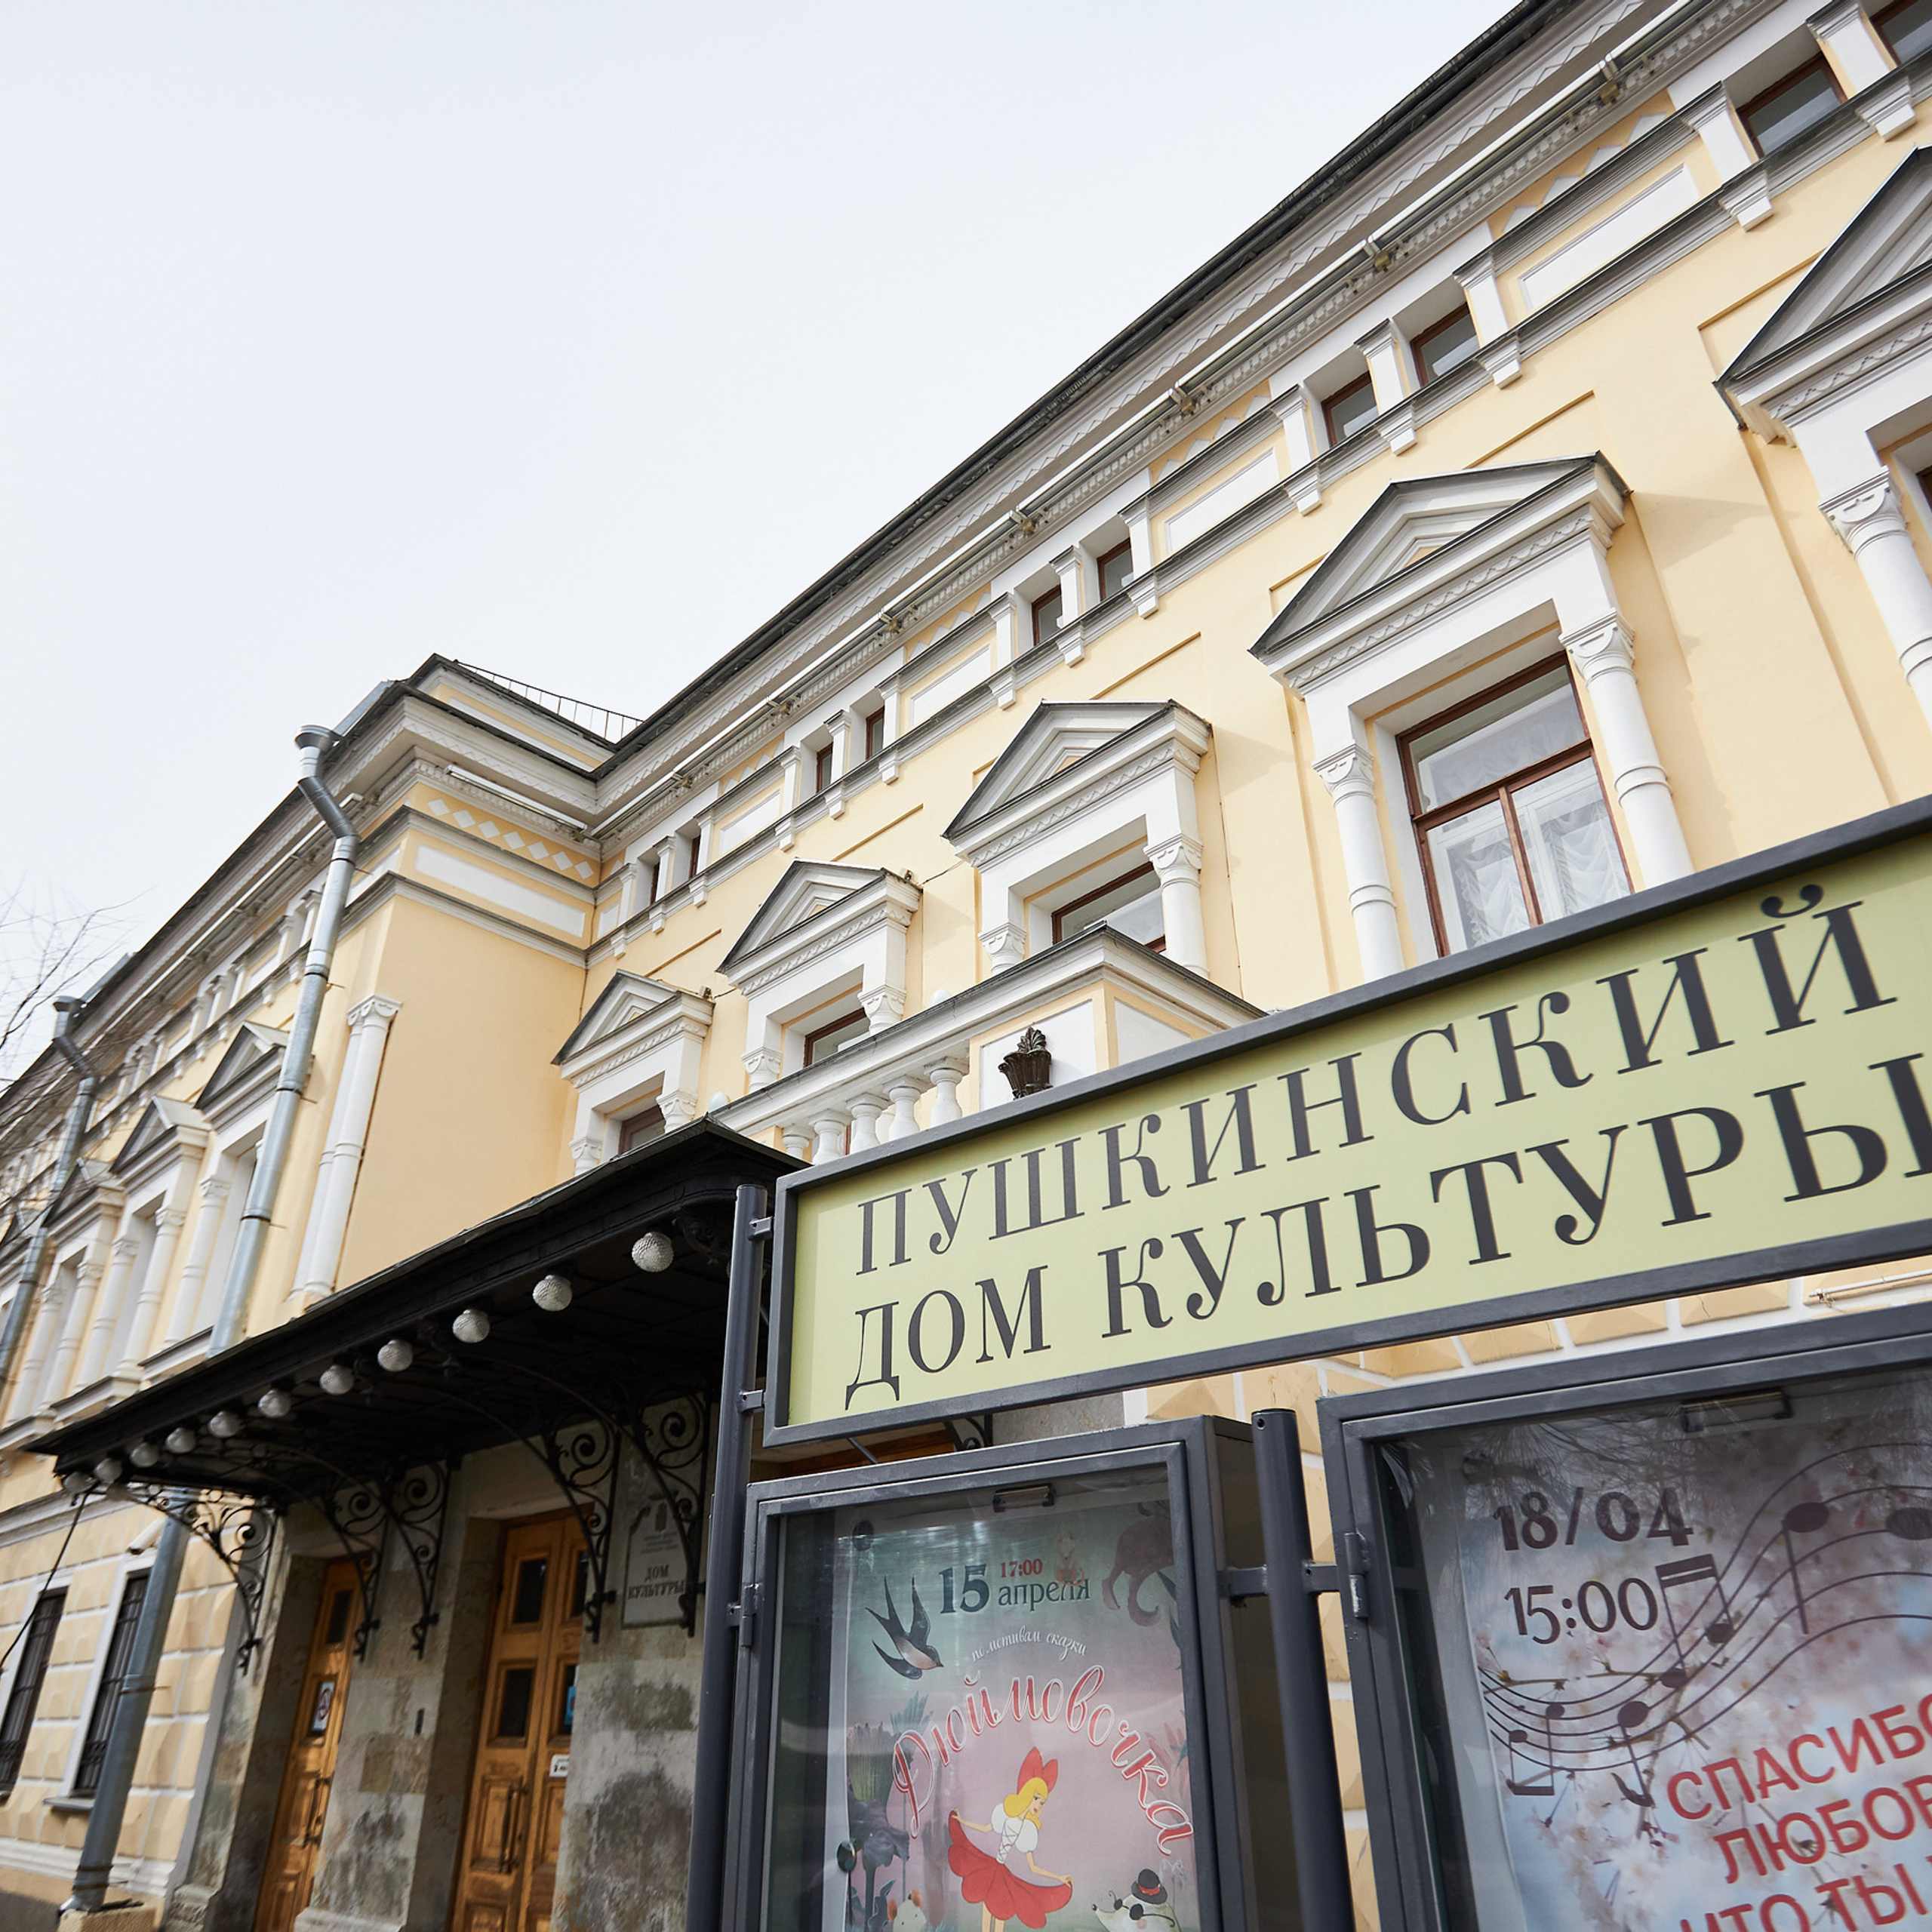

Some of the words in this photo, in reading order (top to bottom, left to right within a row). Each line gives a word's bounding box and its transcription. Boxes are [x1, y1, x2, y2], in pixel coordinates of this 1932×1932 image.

[856, 884, 1898, 1275] ПУШКИНСКИЙ
[844, 1265, 1051, 1411] ДОМ
[1097, 1053, 1932, 1340] КУЛЬТУРЫ
[1494, 1487, 1694, 1551] 18/04
[645, 1564, 669, 1583] ДОМ
[939, 1564, 989, 1614] 15
[998, 1578, 1091, 1612] апреля
[1001, 1558, 1044, 1578] 17:00
[1505, 1577, 1659, 1644] 15:00
[1046, 1632, 1088, 1662] сказки
[891, 1665, 1194, 1857] Дюймовочка
[1666, 1693, 1932, 1820] СПАСИБ
[1815, 1863, 1928, 1932] ТЫ
